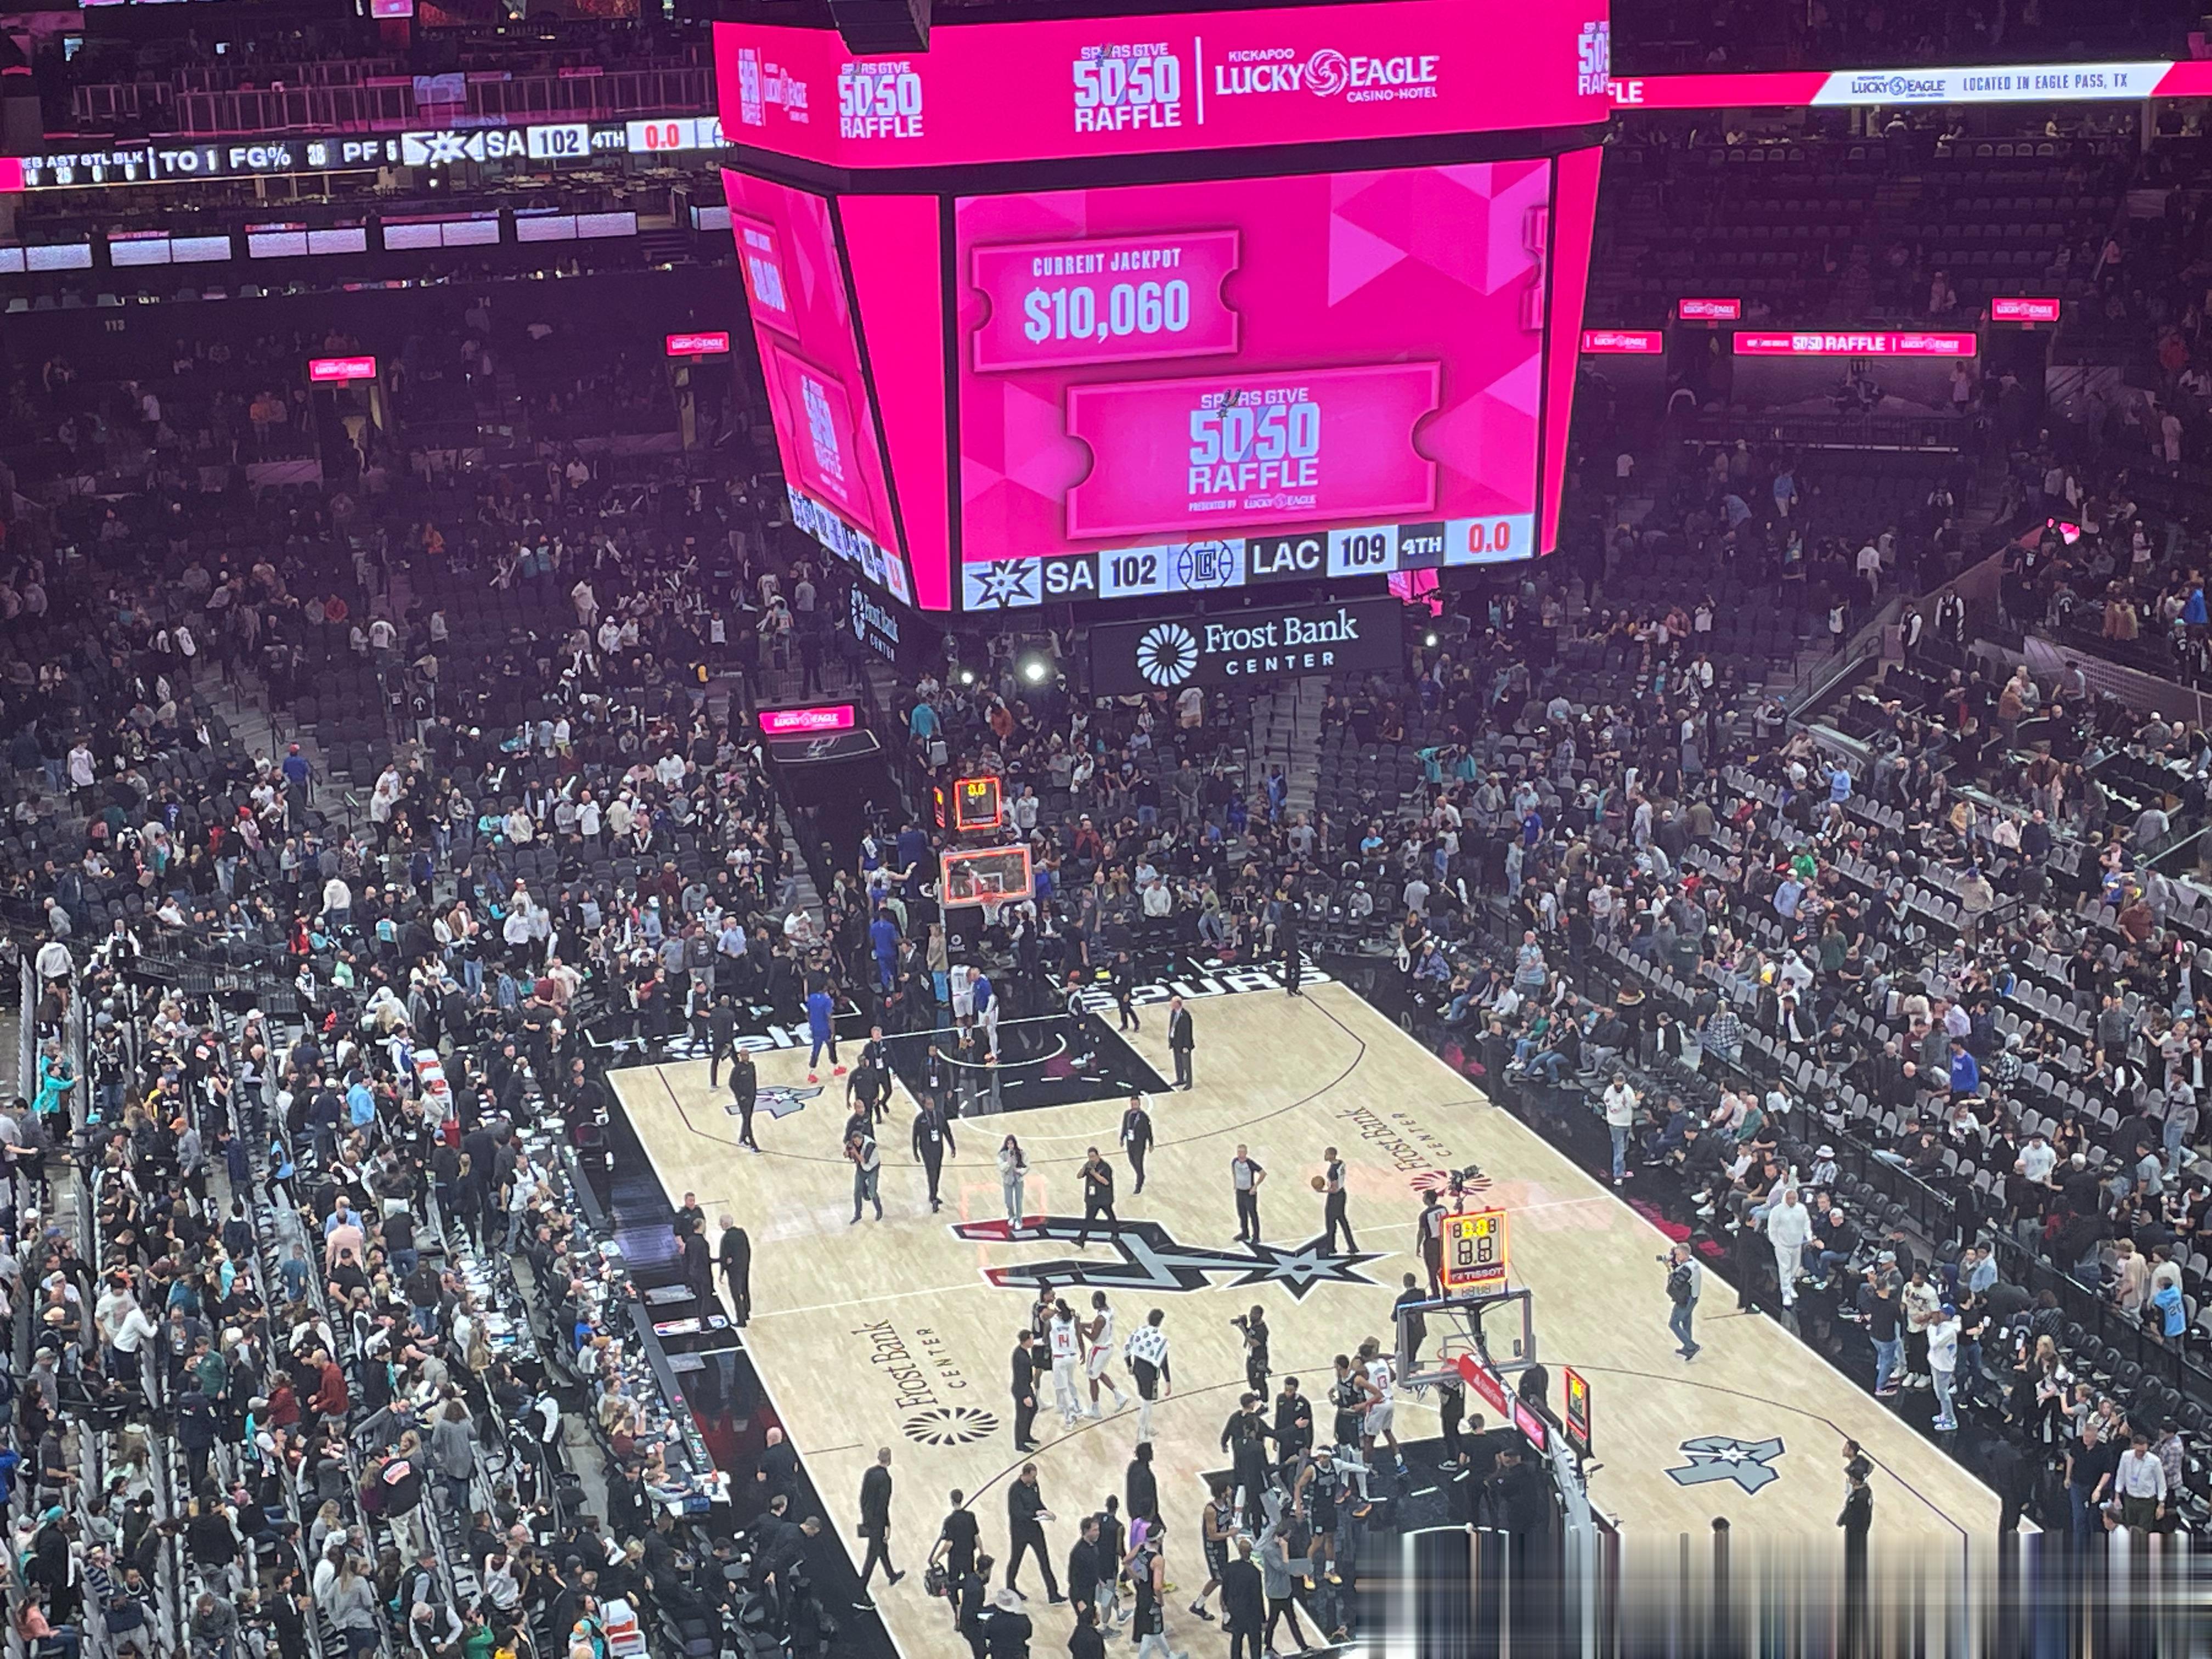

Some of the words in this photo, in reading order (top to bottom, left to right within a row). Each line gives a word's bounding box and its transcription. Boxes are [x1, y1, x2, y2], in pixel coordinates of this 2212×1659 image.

[1133, 42, 1169, 57] GIVE
[1228, 48, 1295, 62] KICKAPOO
[879, 61, 911, 74] GIVE
[1215, 64, 1305, 95] LUCKY
[1350, 55, 1440, 87] EAGLE
[1963, 77, 2011, 91] LOCATED
[2017, 76, 2029, 89] IN
[2035, 74, 2069, 89] EAGLE
[2075, 74, 2107, 89] PASS,
[2114, 73, 2128, 87] TX
[1852, 81, 1888, 93] LUCKY
[1906, 80, 1946, 92] EAGLE
[840, 116, 924, 139] RAFFLE
[1075, 103, 1183, 133] RAFFLE
[487, 130, 526, 157] SA
[539, 129, 580, 155] 102
[591, 130, 625, 148] 4TH
[645, 123, 680, 149] 0.0
[21, 156, 43, 170] EB
[47, 155, 78, 168] AST
[81, 153, 111, 167] STL
[113, 150, 144, 165] BLK
[160, 150, 199, 172] TO
[207, 150, 217, 171] 1
[229, 144, 292, 168] FG%
[342, 141, 379, 162] PF
[1032, 253, 1104, 276] CURRENT
[1110, 248, 1182, 272] JACKPOT
[1024, 279, 1189, 344] $10,060
[1825, 336, 1886, 351] RAFFLE
[1265, 387, 1309, 404] GIVE
[1188, 457, 1319, 494] RAFFLE
[1046, 560, 1094, 594] SA
[1111, 554, 1158, 588] 102
[1252, 539, 1321, 575] LAC
[1341, 533, 1387, 567] 109
[1401, 536, 1443, 556] 4TH
[1468, 521, 1511, 554] 0.0
[1204, 621, 1278, 653] Frost
[1283, 607, 1359, 646] Bank
[1226, 652, 1335, 676] CENTER
[1335, 1106, 1396, 1139] Bank
[1392, 1113, 1452, 1157] CENTER
[1376, 1138, 1432, 1172] Frost
[1464, 1267, 1503, 1280] TISSOT
[851, 1319, 911, 1364] Bank
[916, 1328, 967, 1389] CENTER
[883, 1363, 939, 1409] Frost
